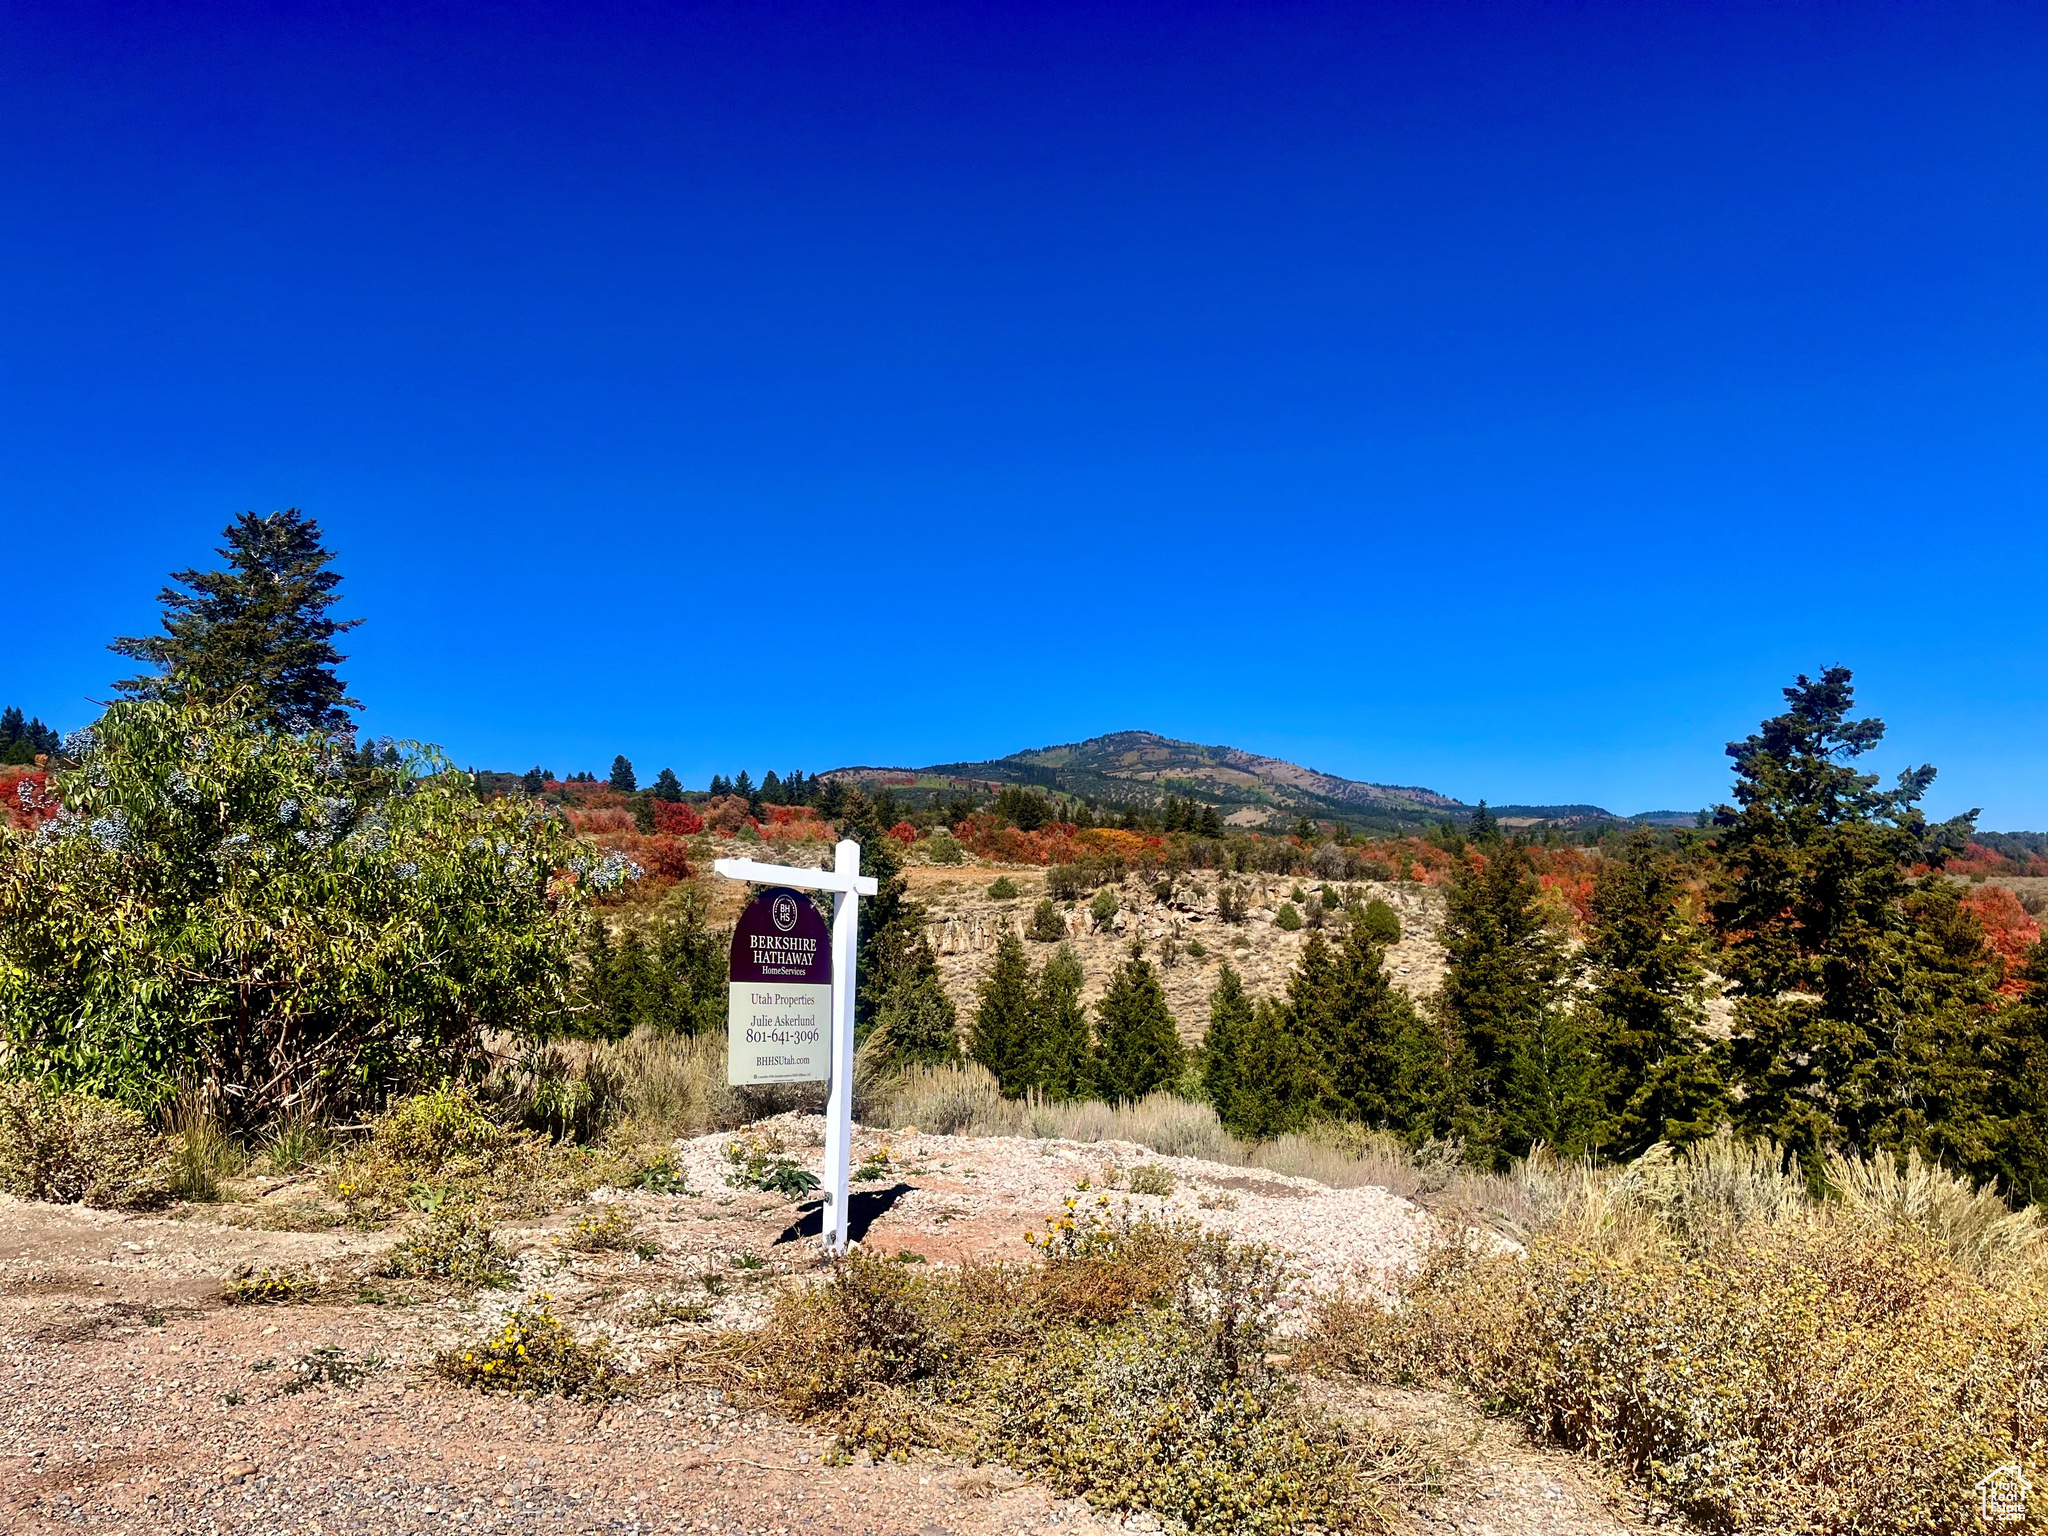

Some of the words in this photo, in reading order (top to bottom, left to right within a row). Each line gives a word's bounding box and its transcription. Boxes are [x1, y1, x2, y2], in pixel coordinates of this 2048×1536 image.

[780, 903, 790, 913] BH
[780, 912, 790, 922] HS
[750, 935, 817, 952] BERKSHIRE
[753, 950, 815, 966] HATHAWAY
[762, 965, 806, 976] HomeServices
[751, 993, 772, 1005] Utah
[775, 993, 815, 1007] Properties
[751, 1015, 773, 1027] Julie
[774, 1014, 815, 1027] Askerlund
[746, 1028, 819, 1045] 801-641-3096
[756, 1055, 810, 1066] BHHSUtah.com
